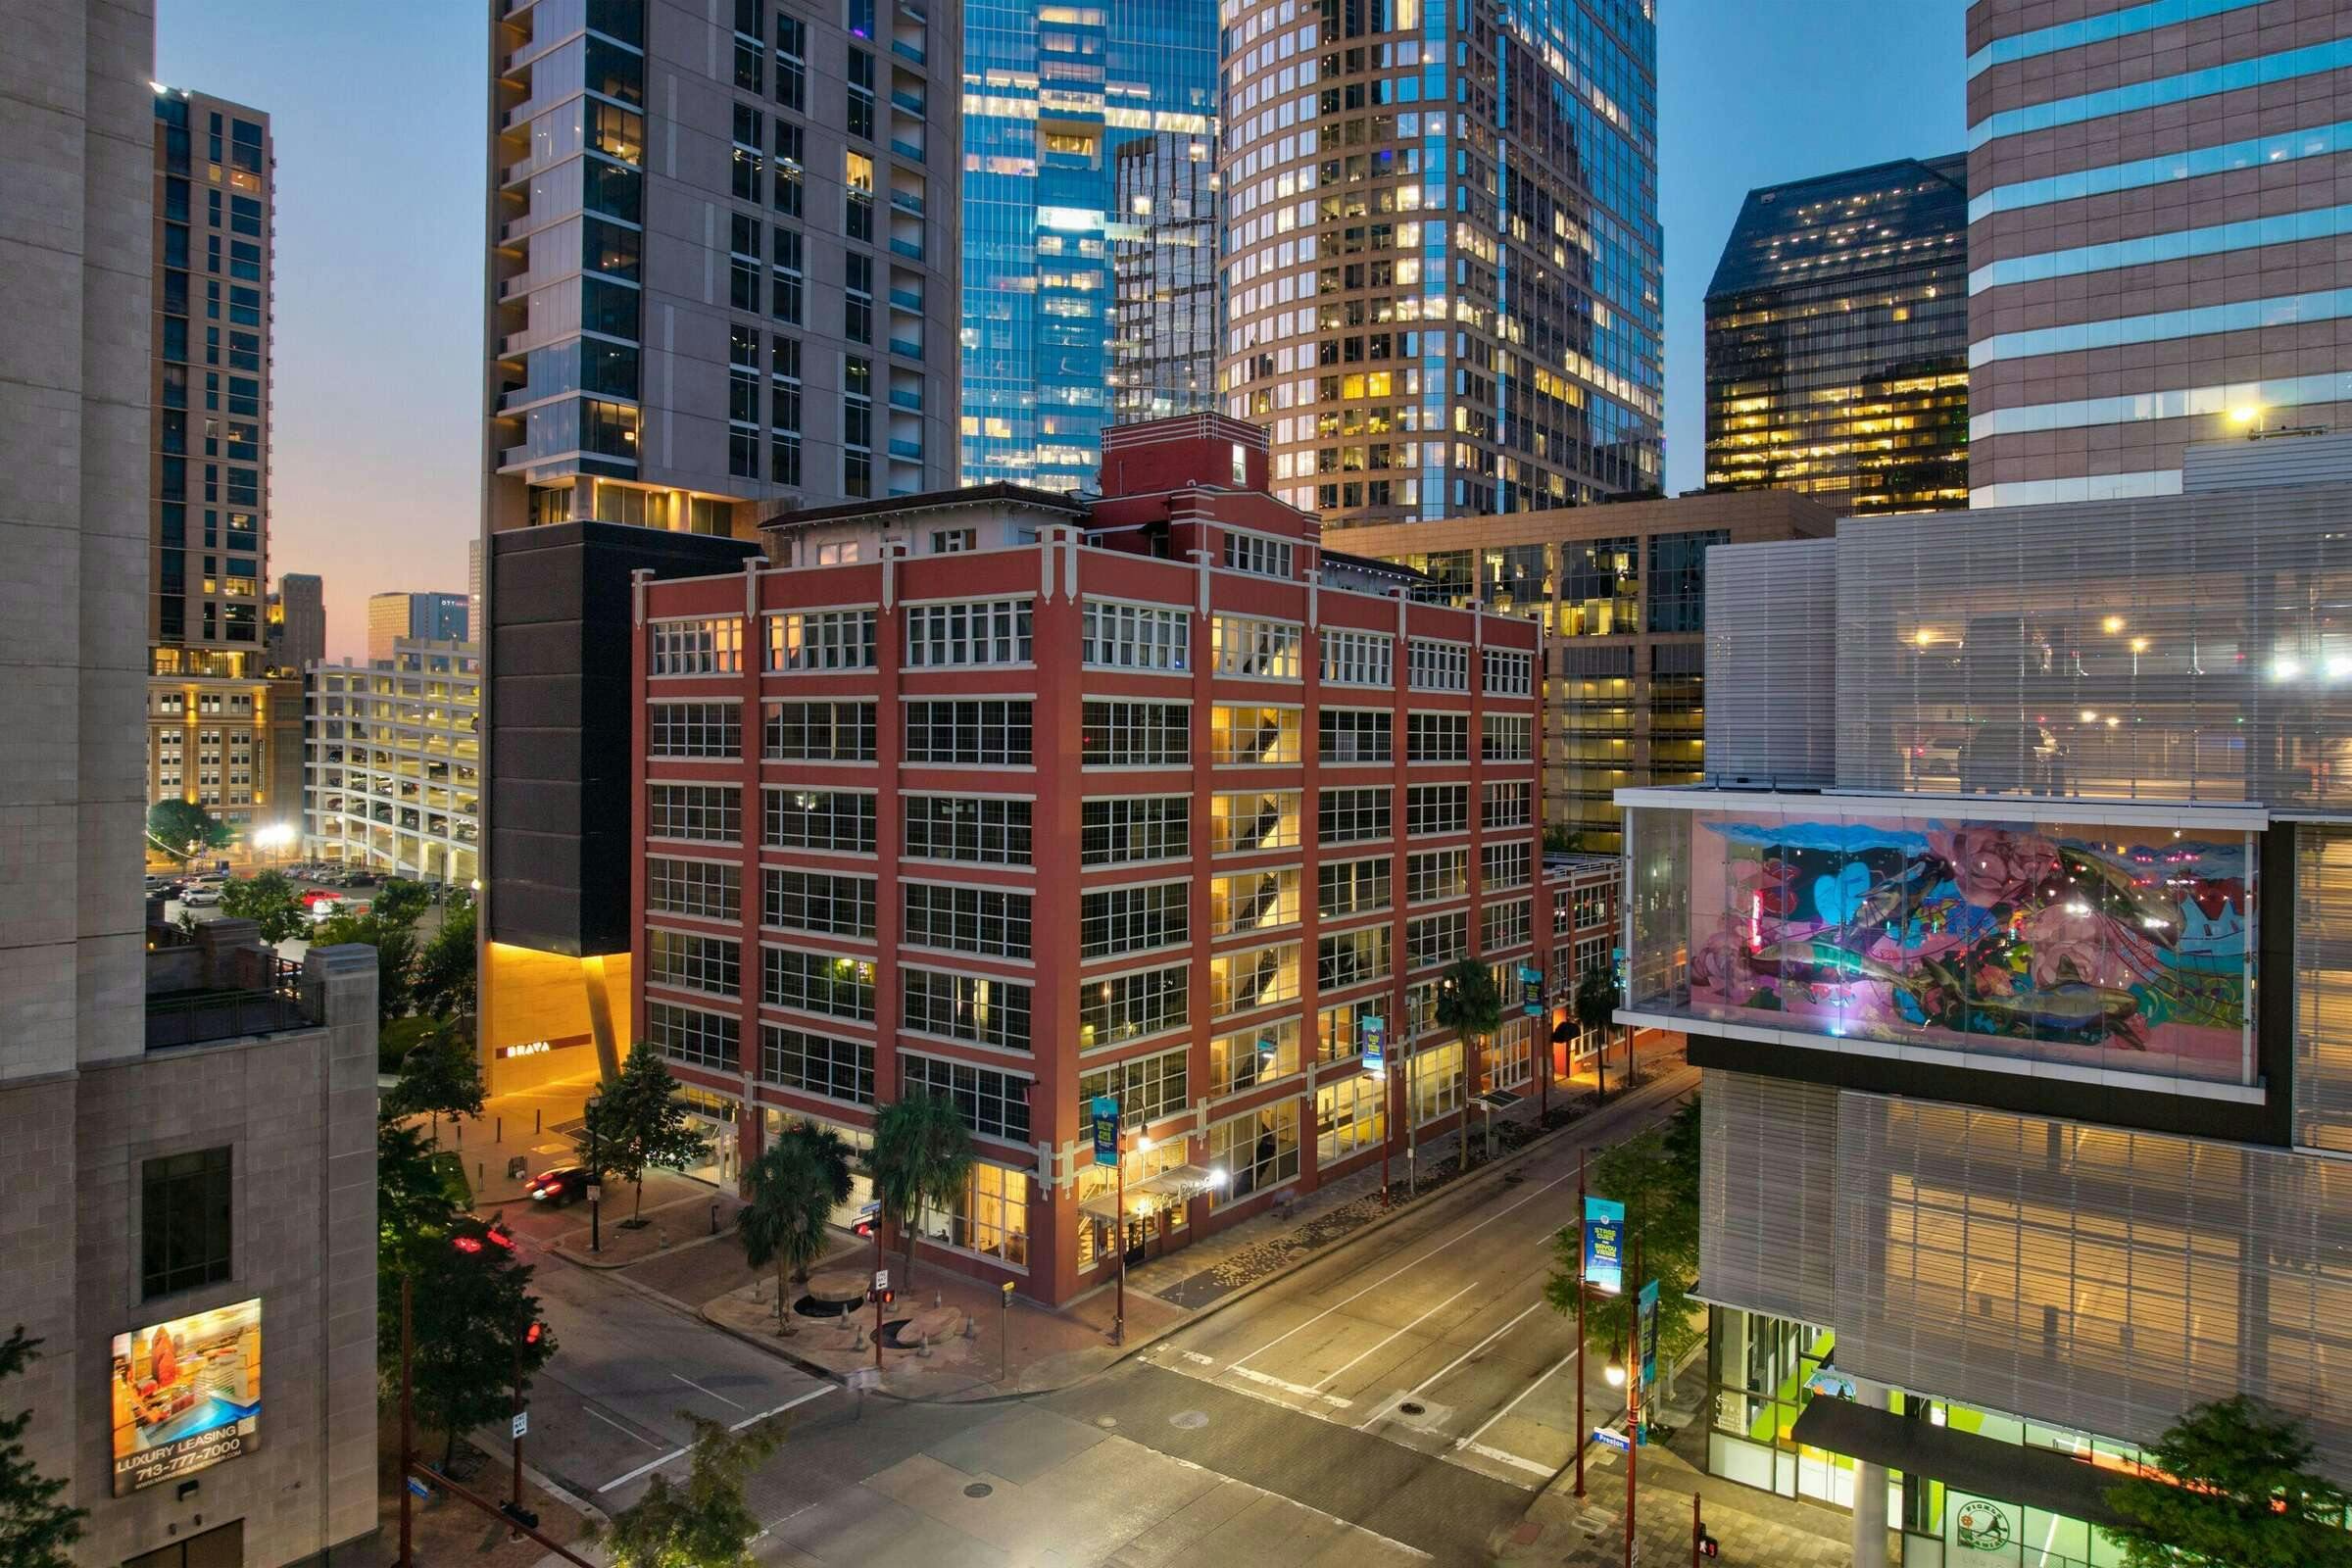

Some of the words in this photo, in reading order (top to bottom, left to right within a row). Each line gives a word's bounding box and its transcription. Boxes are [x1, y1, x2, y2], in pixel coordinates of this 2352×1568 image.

[508, 1042, 549, 1057] BRAVA
[117, 1445, 174, 1472] LUXURY
[177, 1425, 236, 1452] LEASING
[1598, 1434, 1625, 1448] Preston
[136, 1439, 240, 1482] 713-777-7000
